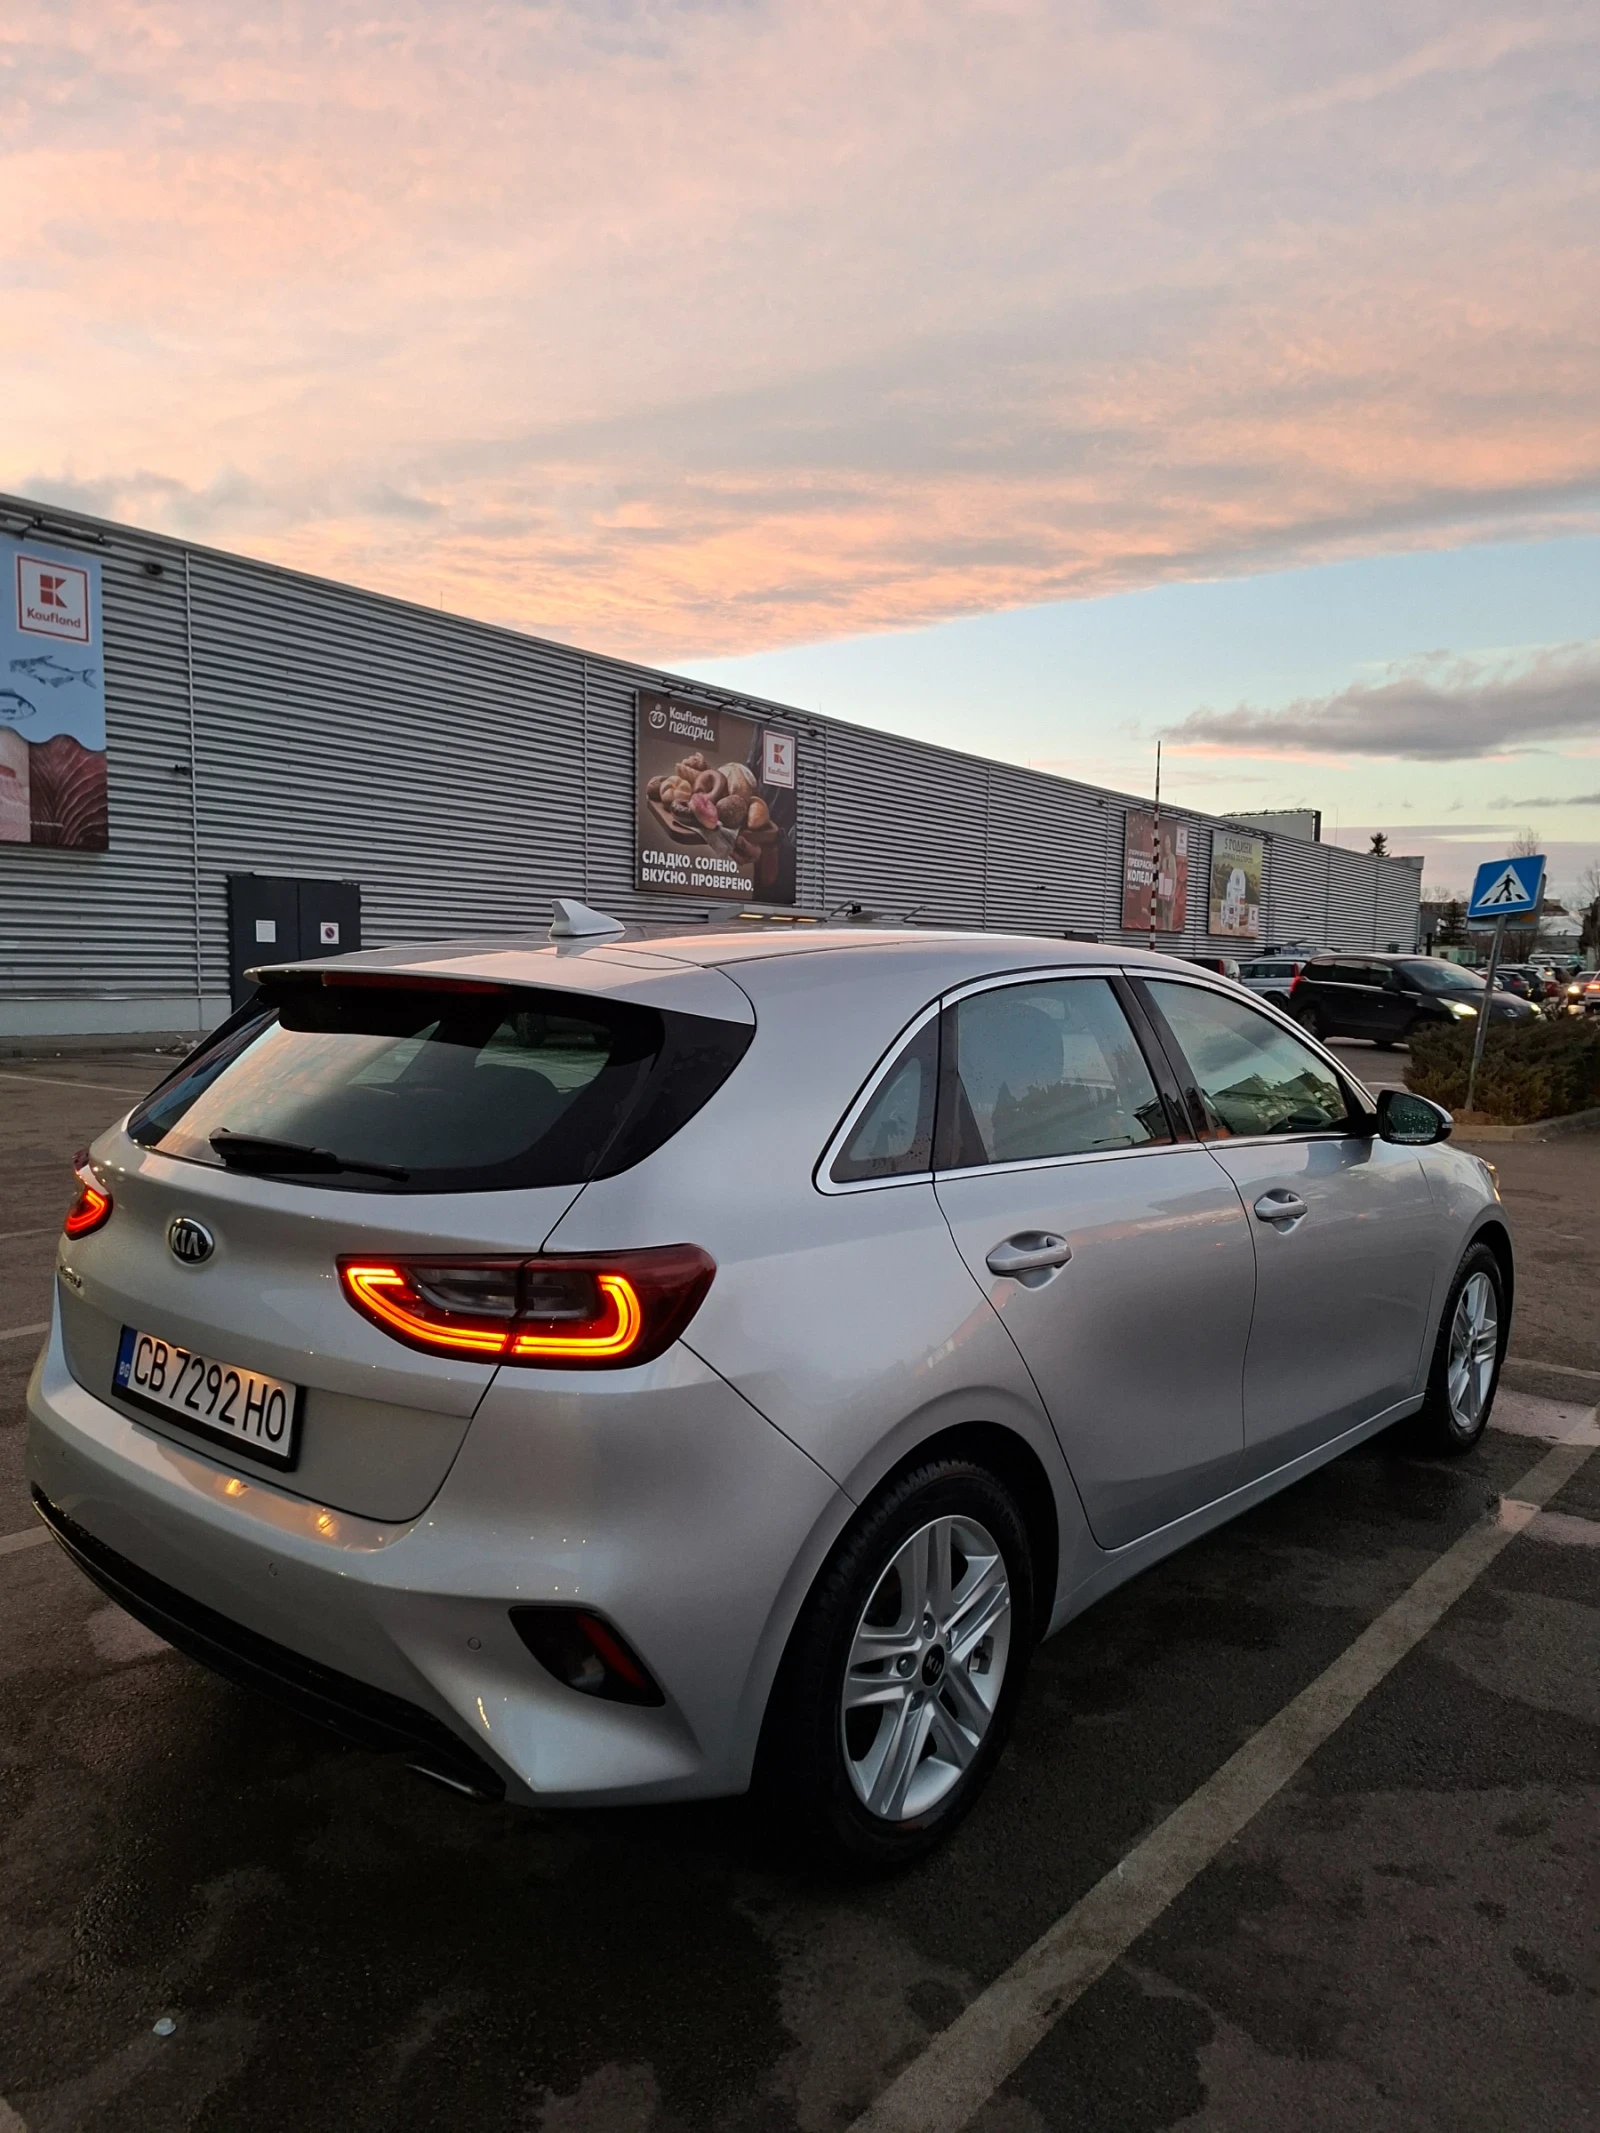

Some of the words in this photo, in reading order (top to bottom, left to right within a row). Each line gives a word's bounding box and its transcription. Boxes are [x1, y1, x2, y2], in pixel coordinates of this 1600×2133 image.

[26, 606, 81, 629] Kaufland
[669, 706, 708, 727] Kaufland
[668, 721, 715, 742] пекарна
[642, 850, 693, 869] СЛАДКО.
[695, 857, 739, 874] СОЛЕНО.
[642, 868, 689, 885] ВКУСНО.
[691, 873, 754, 892] ПРОВЕРЕНО.
[171, 1226, 200, 1257] KIA
[119, 1361, 131, 1378] BG
